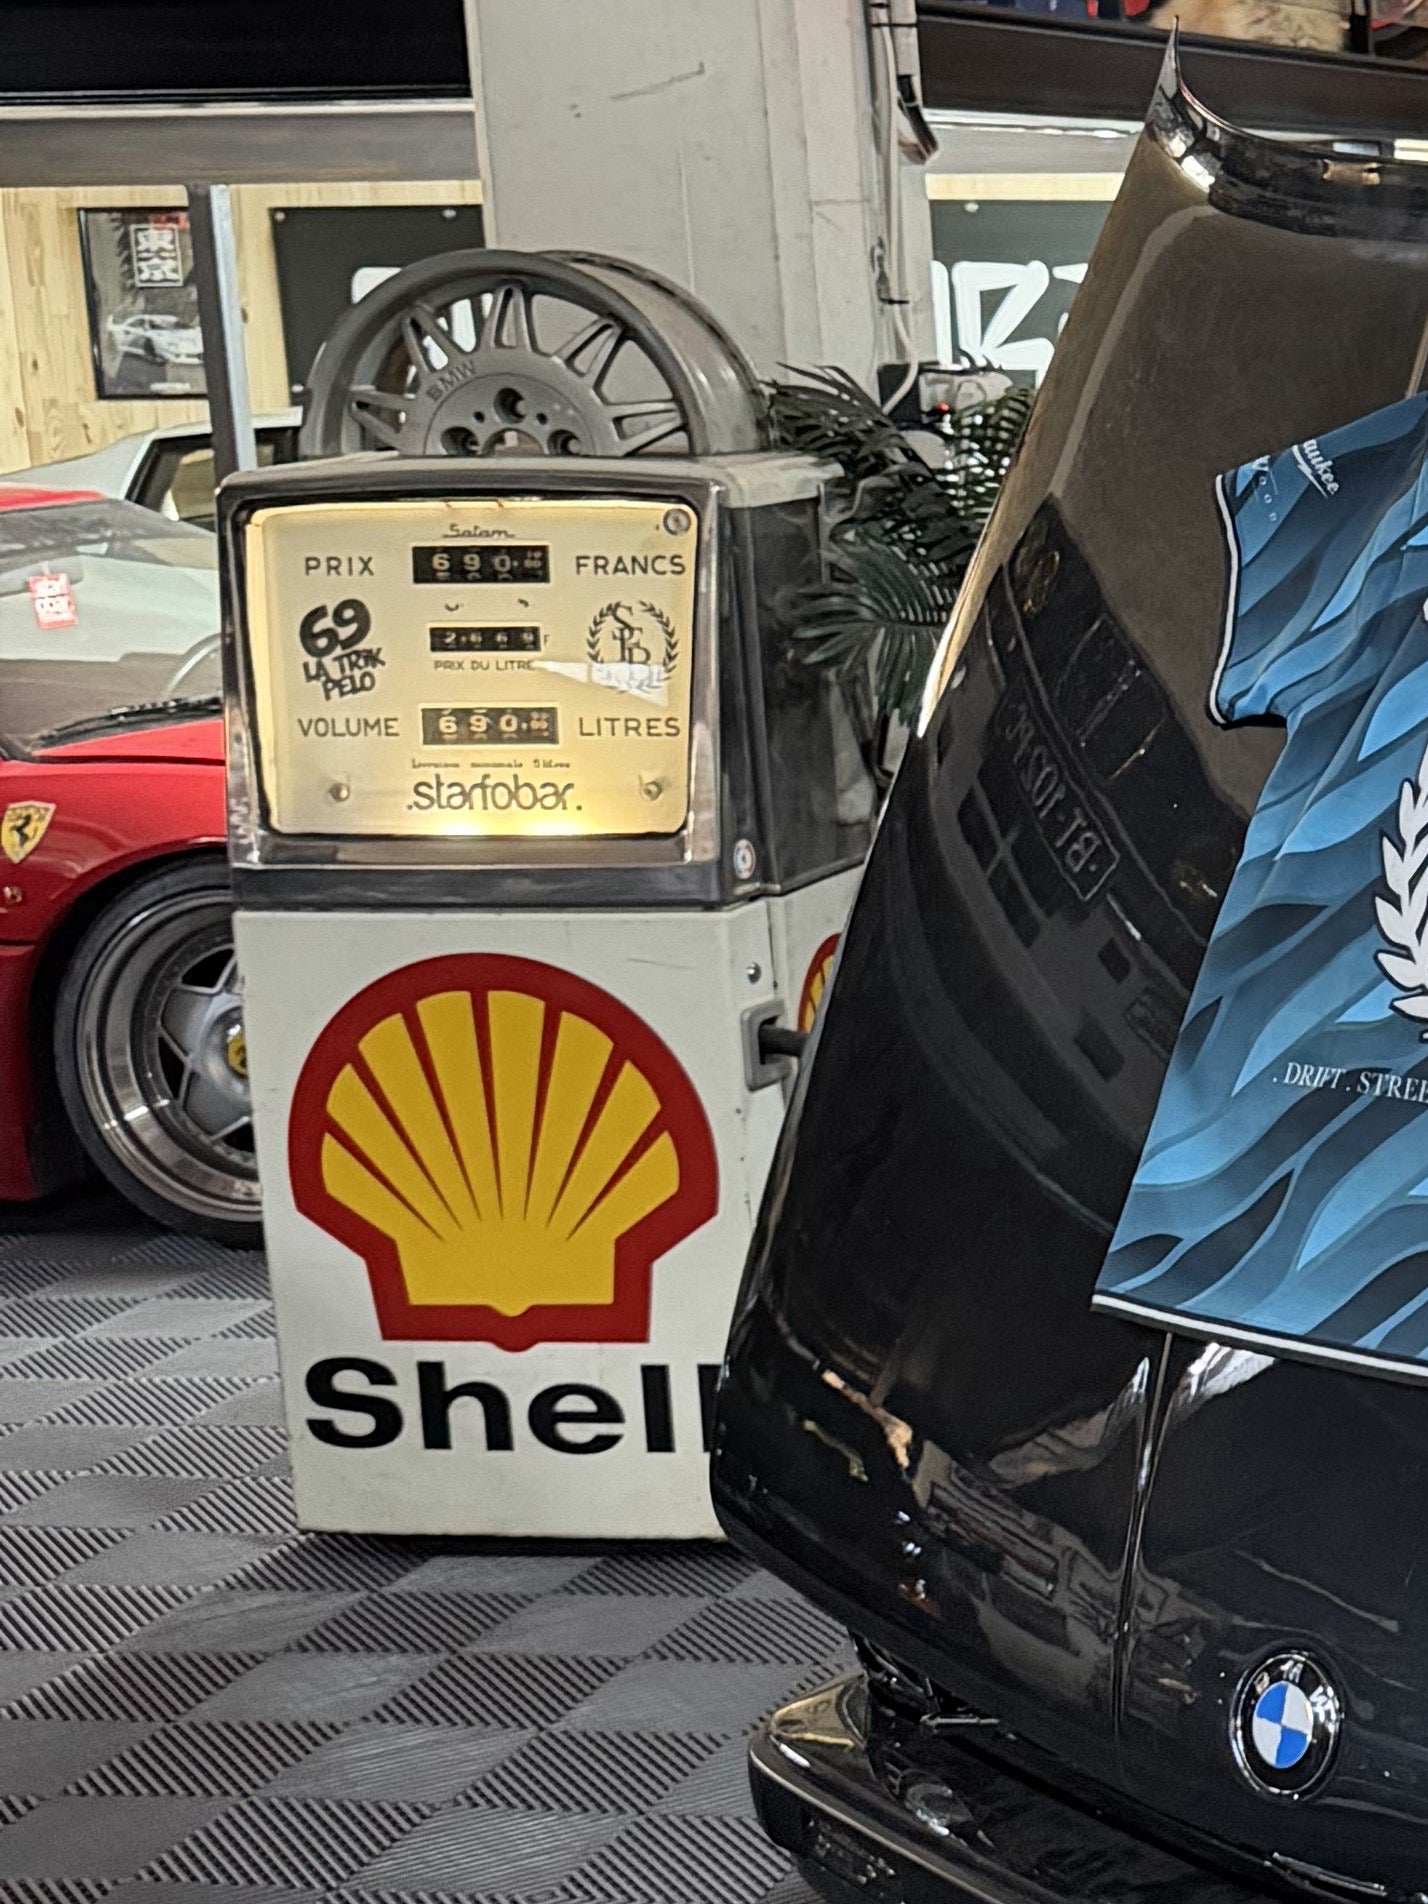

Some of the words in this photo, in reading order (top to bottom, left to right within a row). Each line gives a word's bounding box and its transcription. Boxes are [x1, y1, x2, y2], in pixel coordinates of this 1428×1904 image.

[426, 360, 476, 402] BMW
[304, 556, 374, 576] PRIX
[575, 555, 686, 576] FRANCS
[299, 598, 372, 658] 69
[302, 658, 330, 684] LA
[434, 660, 464, 671] PRIX
[471, 660, 490, 671] DU
[496, 660, 536, 672] LITRE
[321, 671, 377, 702] PELO
[298, 717, 400, 737] VOLUME
[578, 717, 682, 738] LITRES
